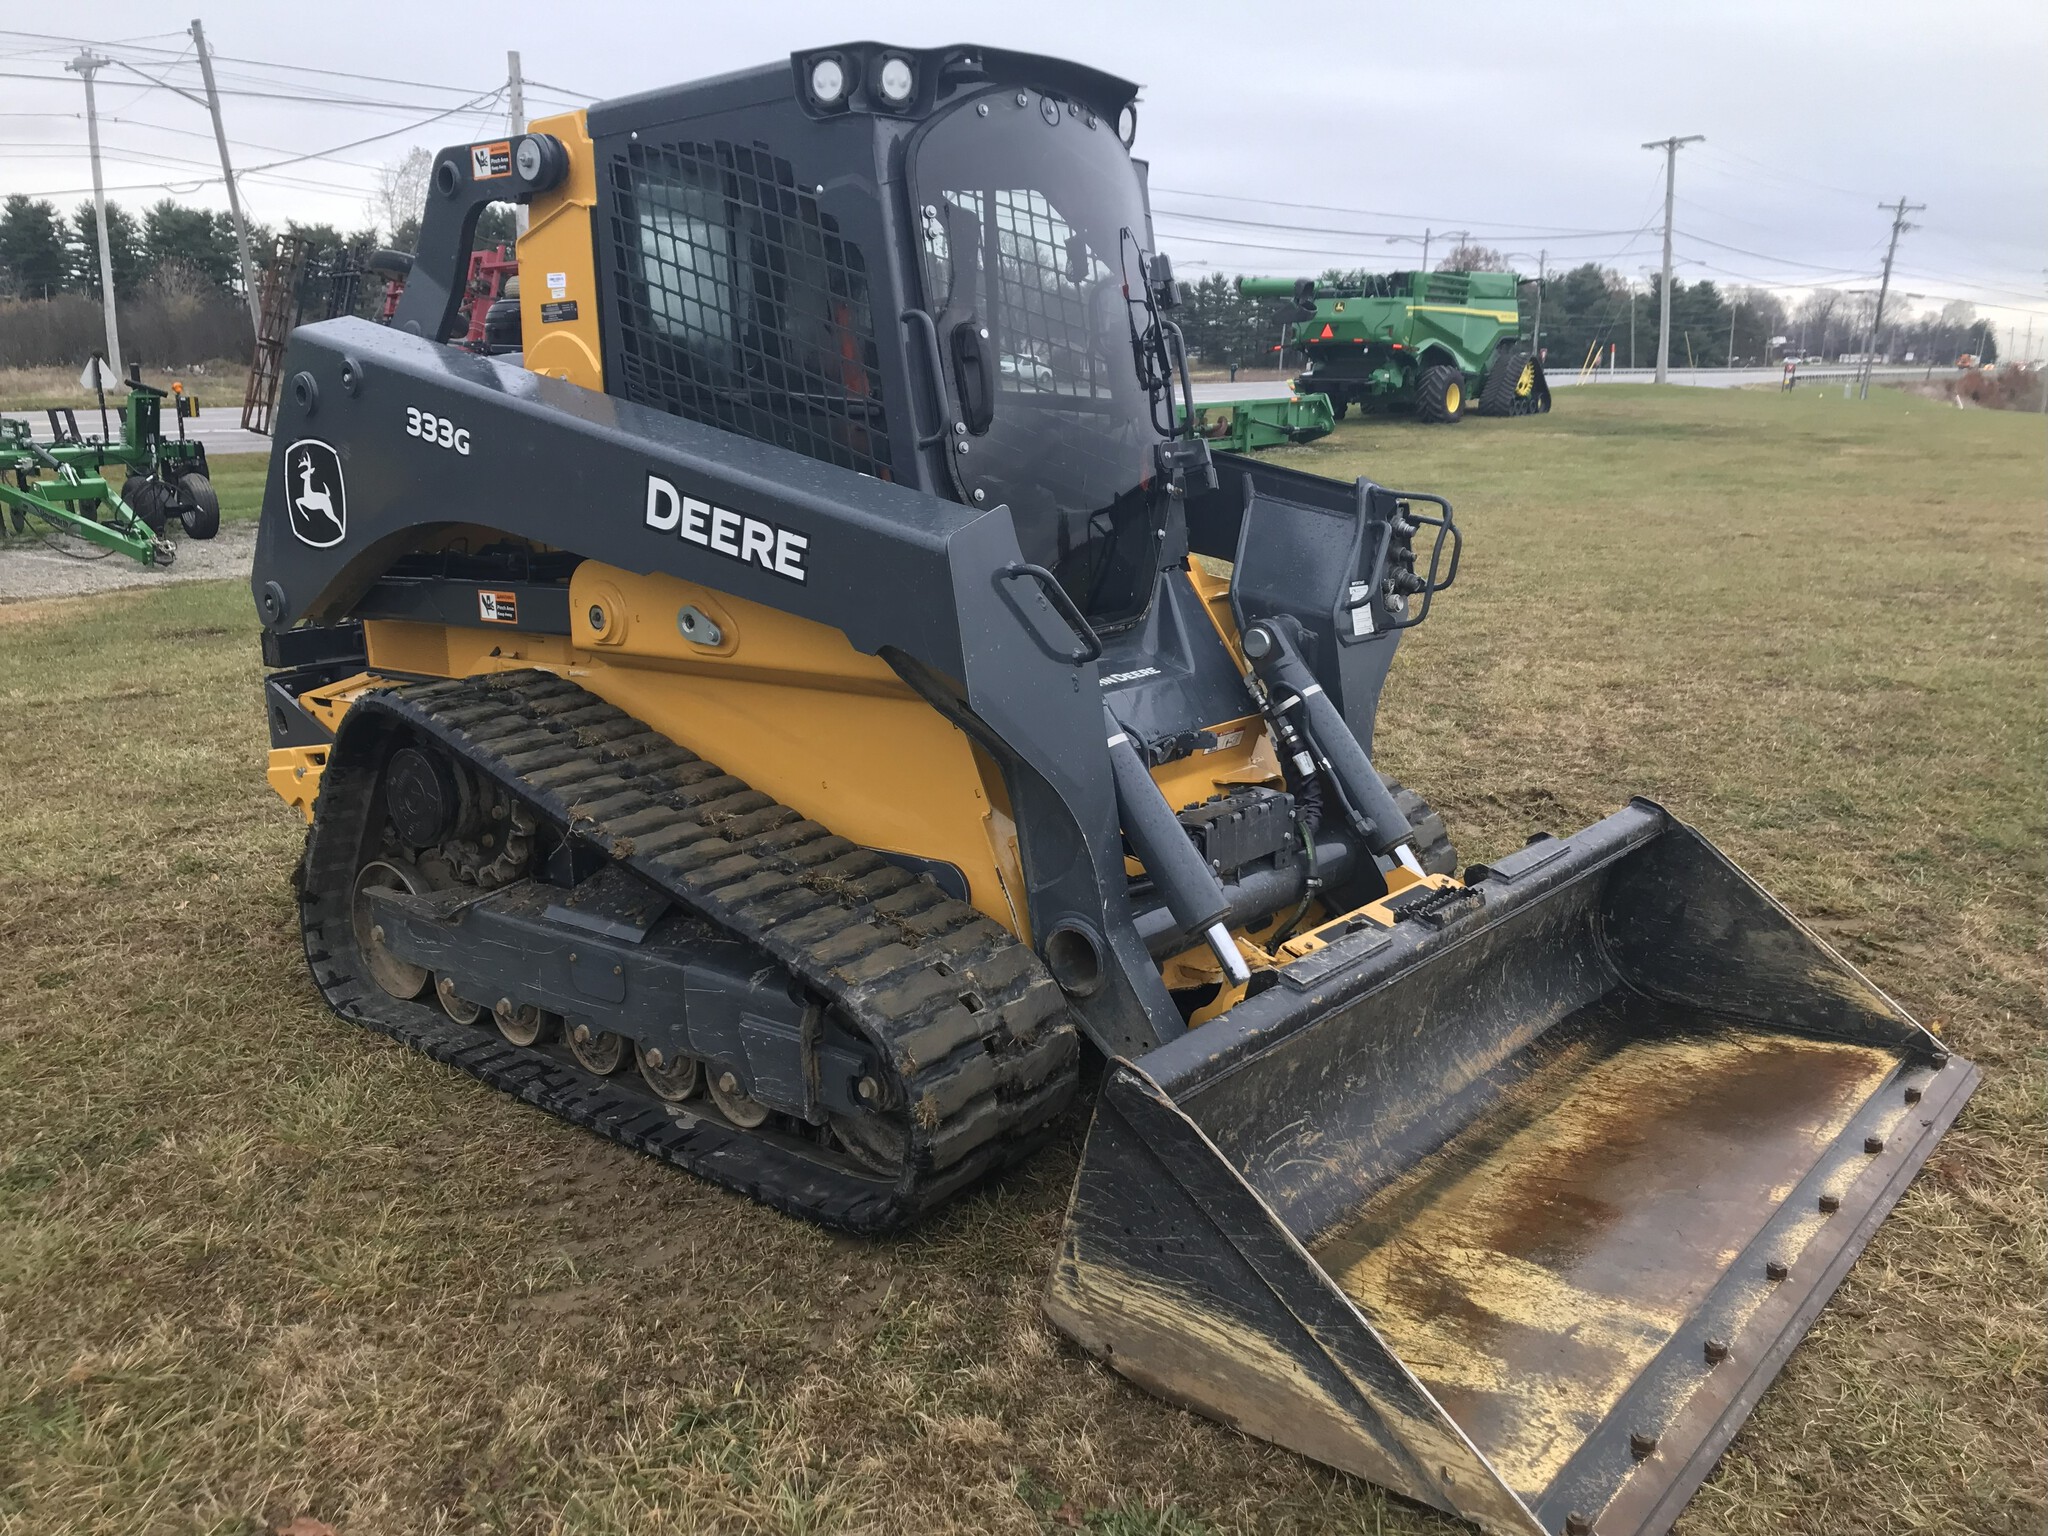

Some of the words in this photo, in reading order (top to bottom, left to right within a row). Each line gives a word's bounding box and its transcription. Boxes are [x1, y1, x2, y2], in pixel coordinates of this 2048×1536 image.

[406, 406, 470, 455] 333G
[646, 475, 808, 581] DEERE
[1110, 667, 1161, 681] DEERE
